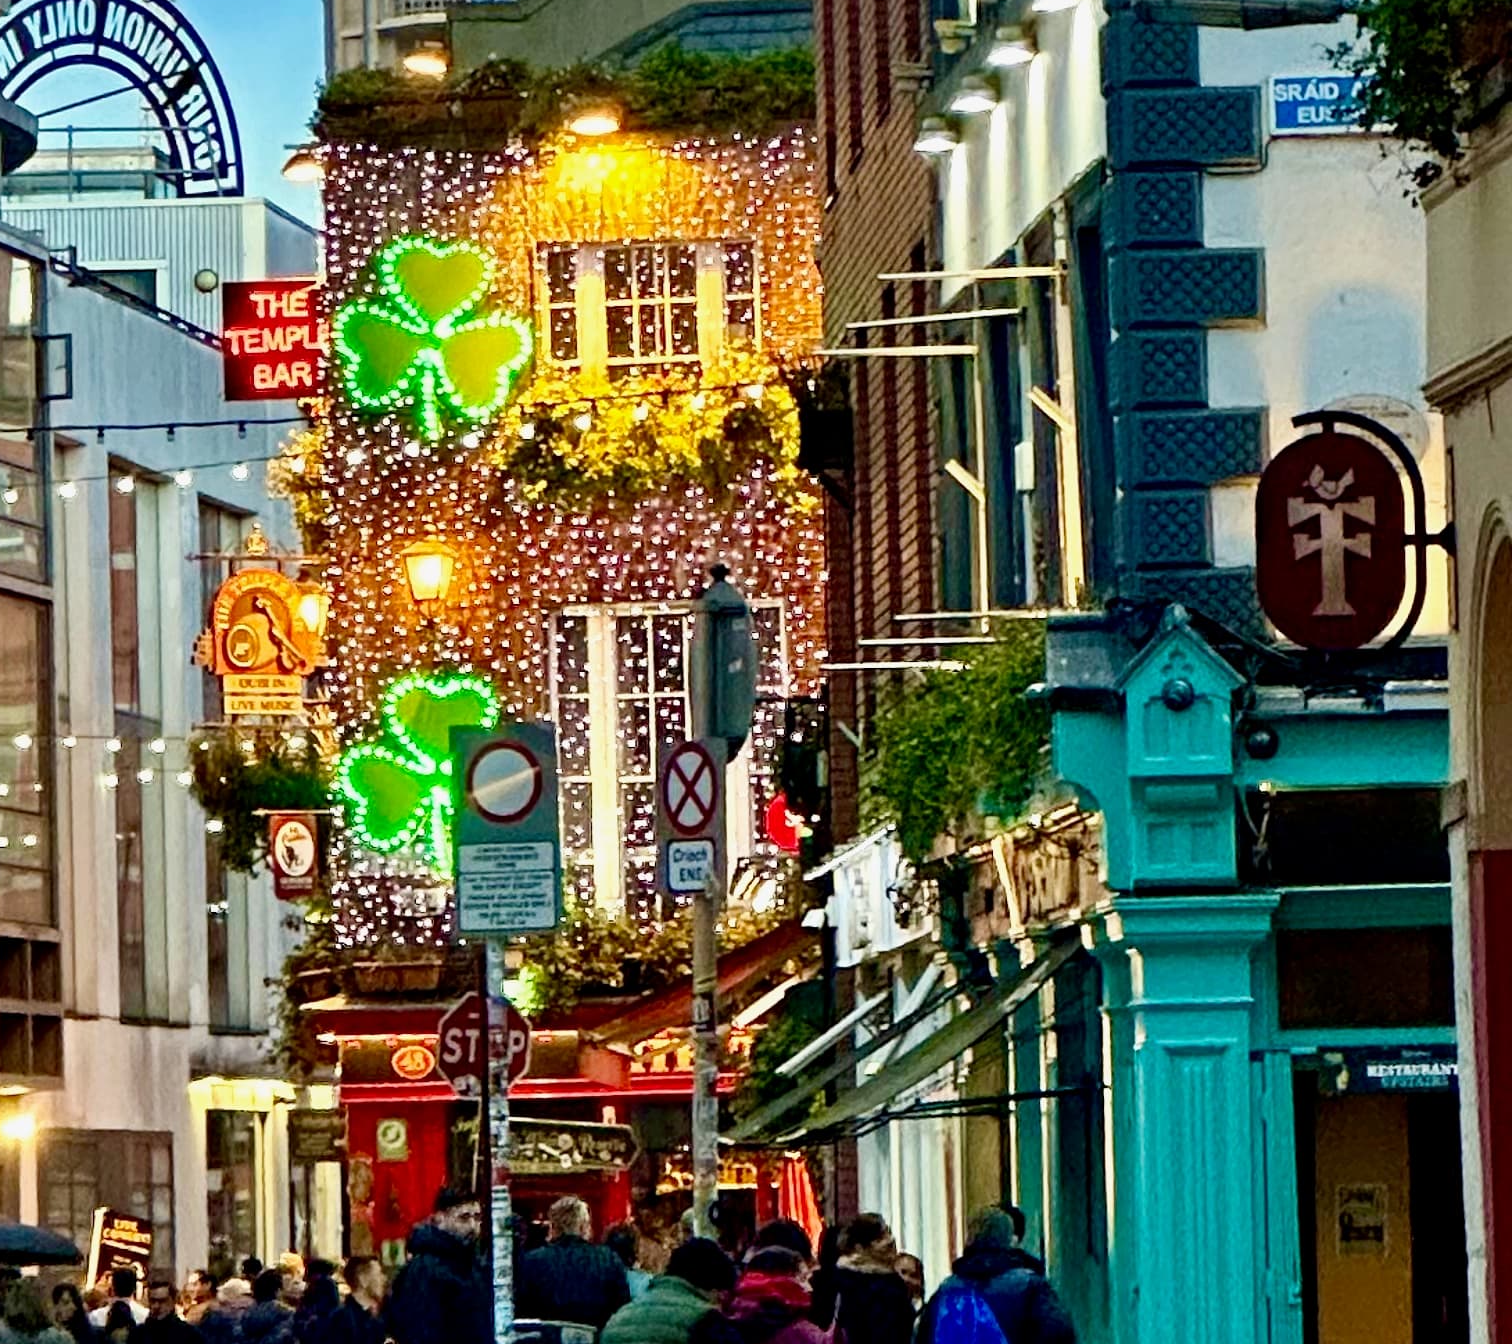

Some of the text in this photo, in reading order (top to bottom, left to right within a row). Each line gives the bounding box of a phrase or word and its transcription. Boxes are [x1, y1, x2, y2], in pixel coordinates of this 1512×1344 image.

[1274, 78, 1340, 102] SRÁID
[249, 290, 310, 319] THE
[224, 322, 330, 356] TEMPLE
[253, 360, 314, 390] BAR
[442, 1027, 526, 1065] STP
